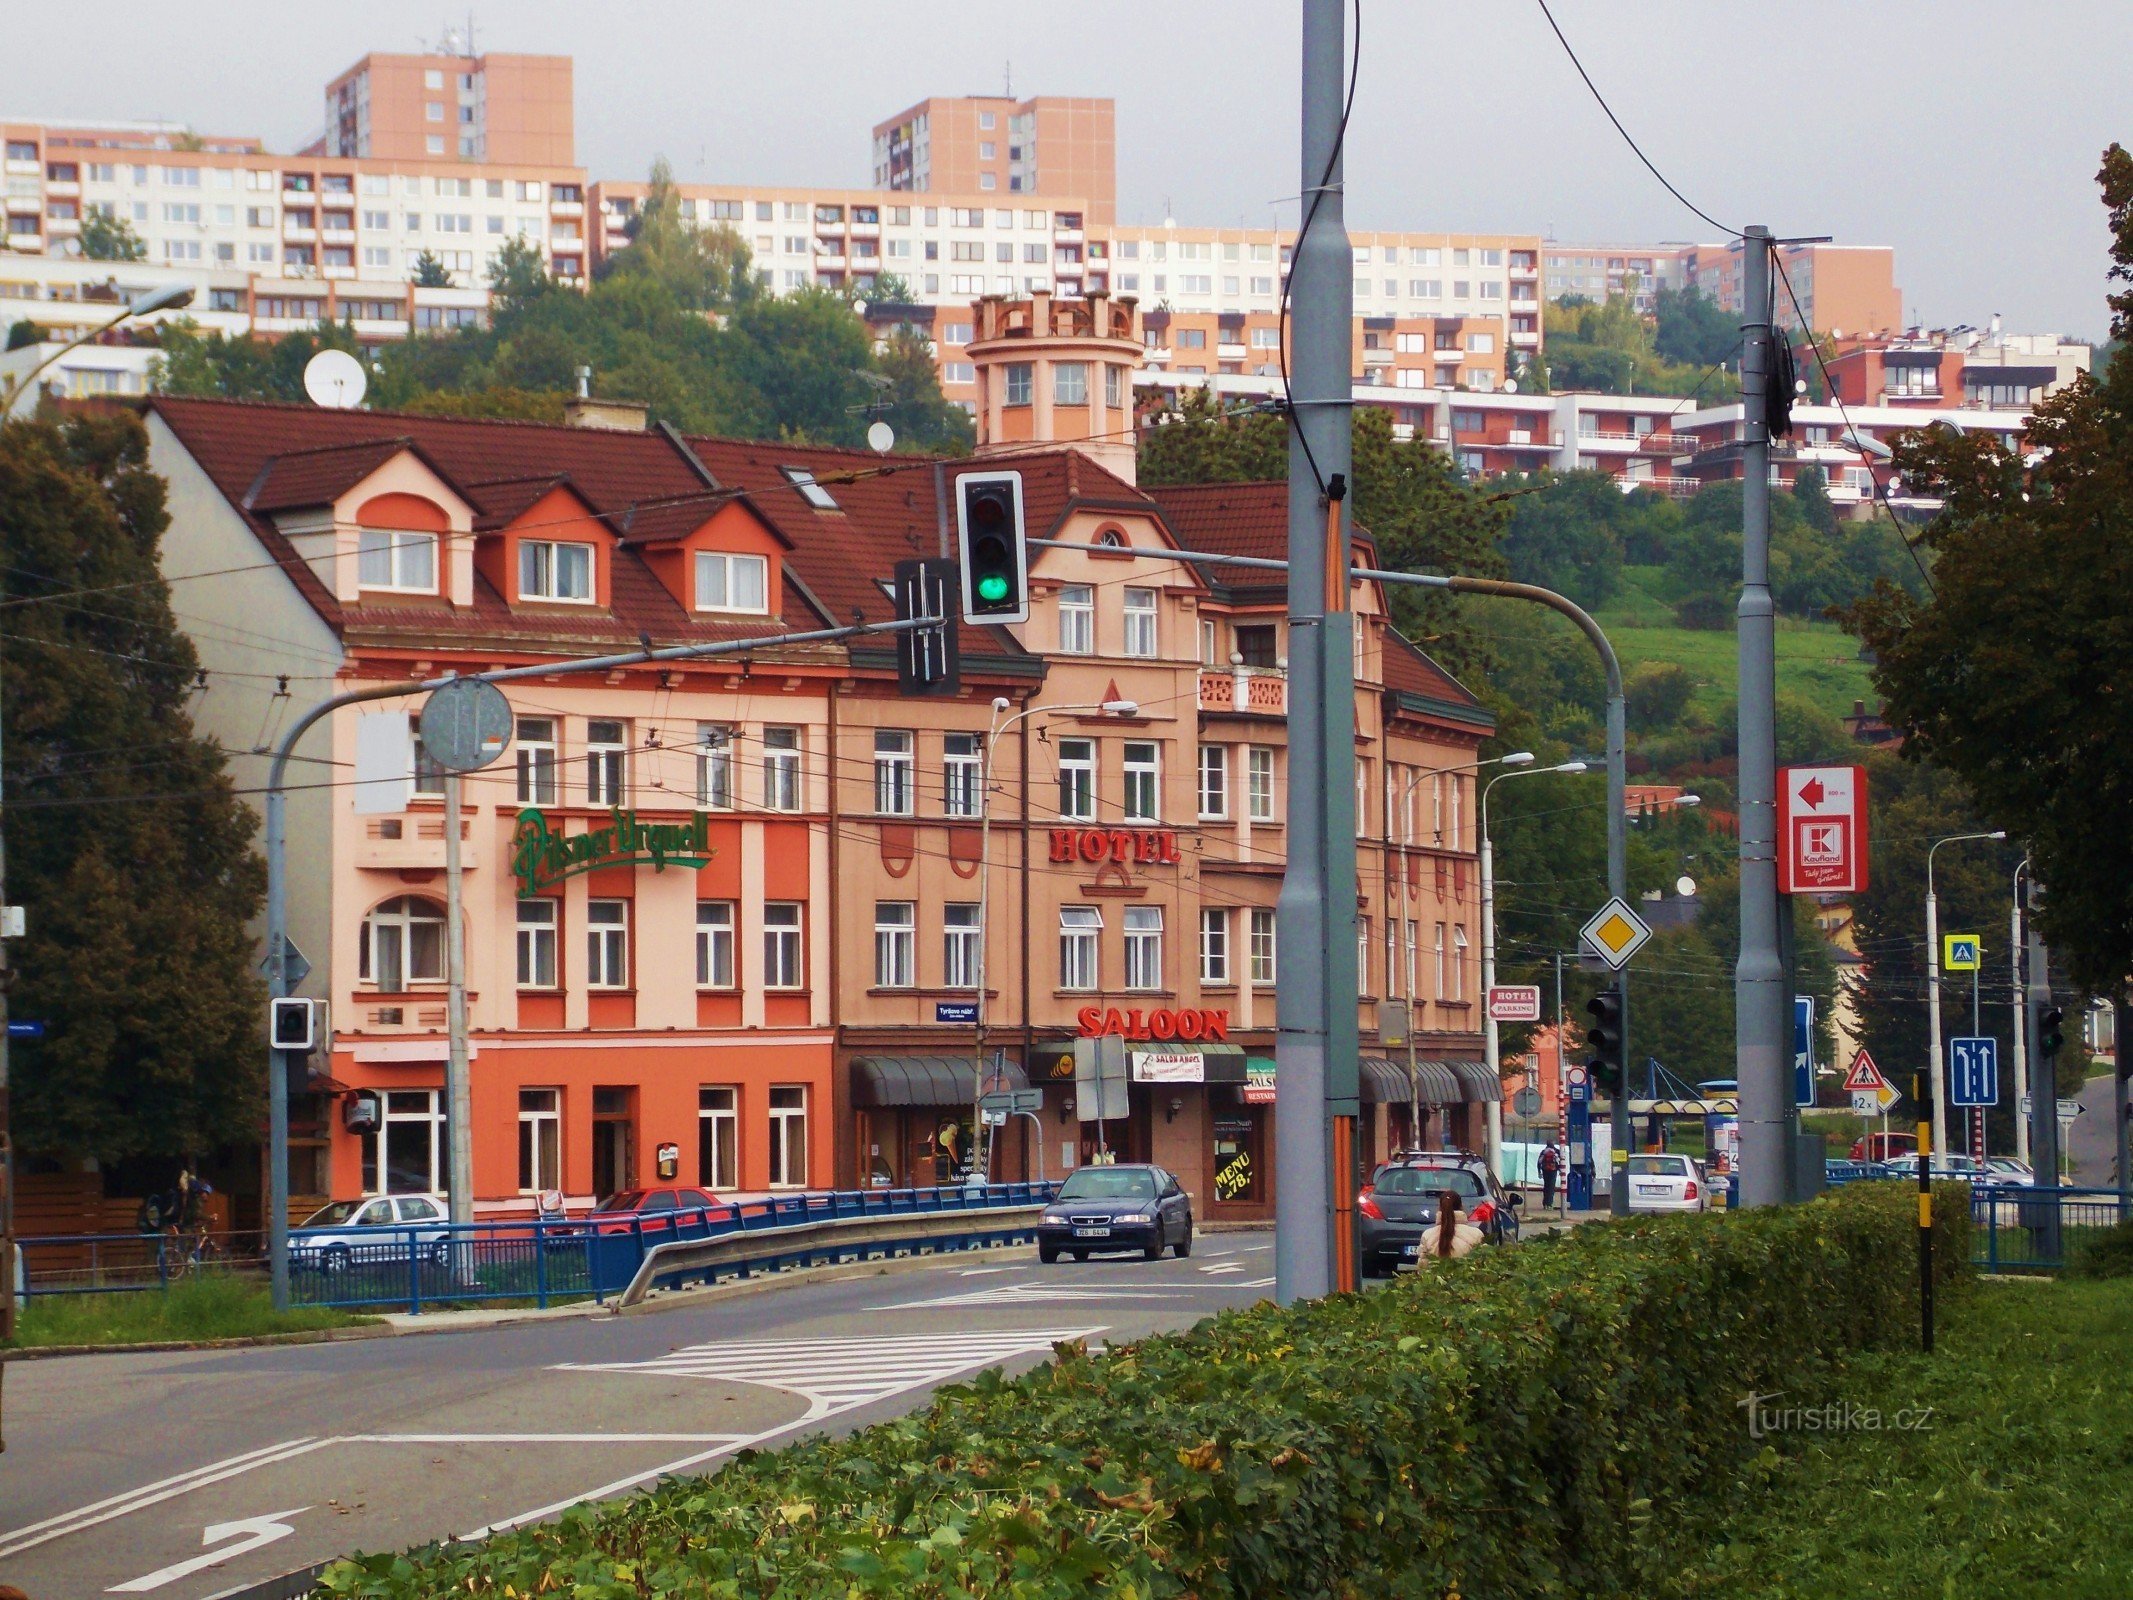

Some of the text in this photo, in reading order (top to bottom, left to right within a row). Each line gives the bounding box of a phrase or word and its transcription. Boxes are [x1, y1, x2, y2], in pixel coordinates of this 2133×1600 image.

[514, 804, 710, 899] Pilsner Urquell
[1049, 829, 1182, 864] HOTEL
[1497, 992, 1534, 1000] HOTEL
[1077, 1006, 1230, 1041] SALOON
[1155, 1055, 1200, 1063] SALON ANGEL
[1858, 1097, 1866, 1109] 2
[1215, 1151, 1250, 1189] MENU
[1225, 1190, 1234, 1200] od
